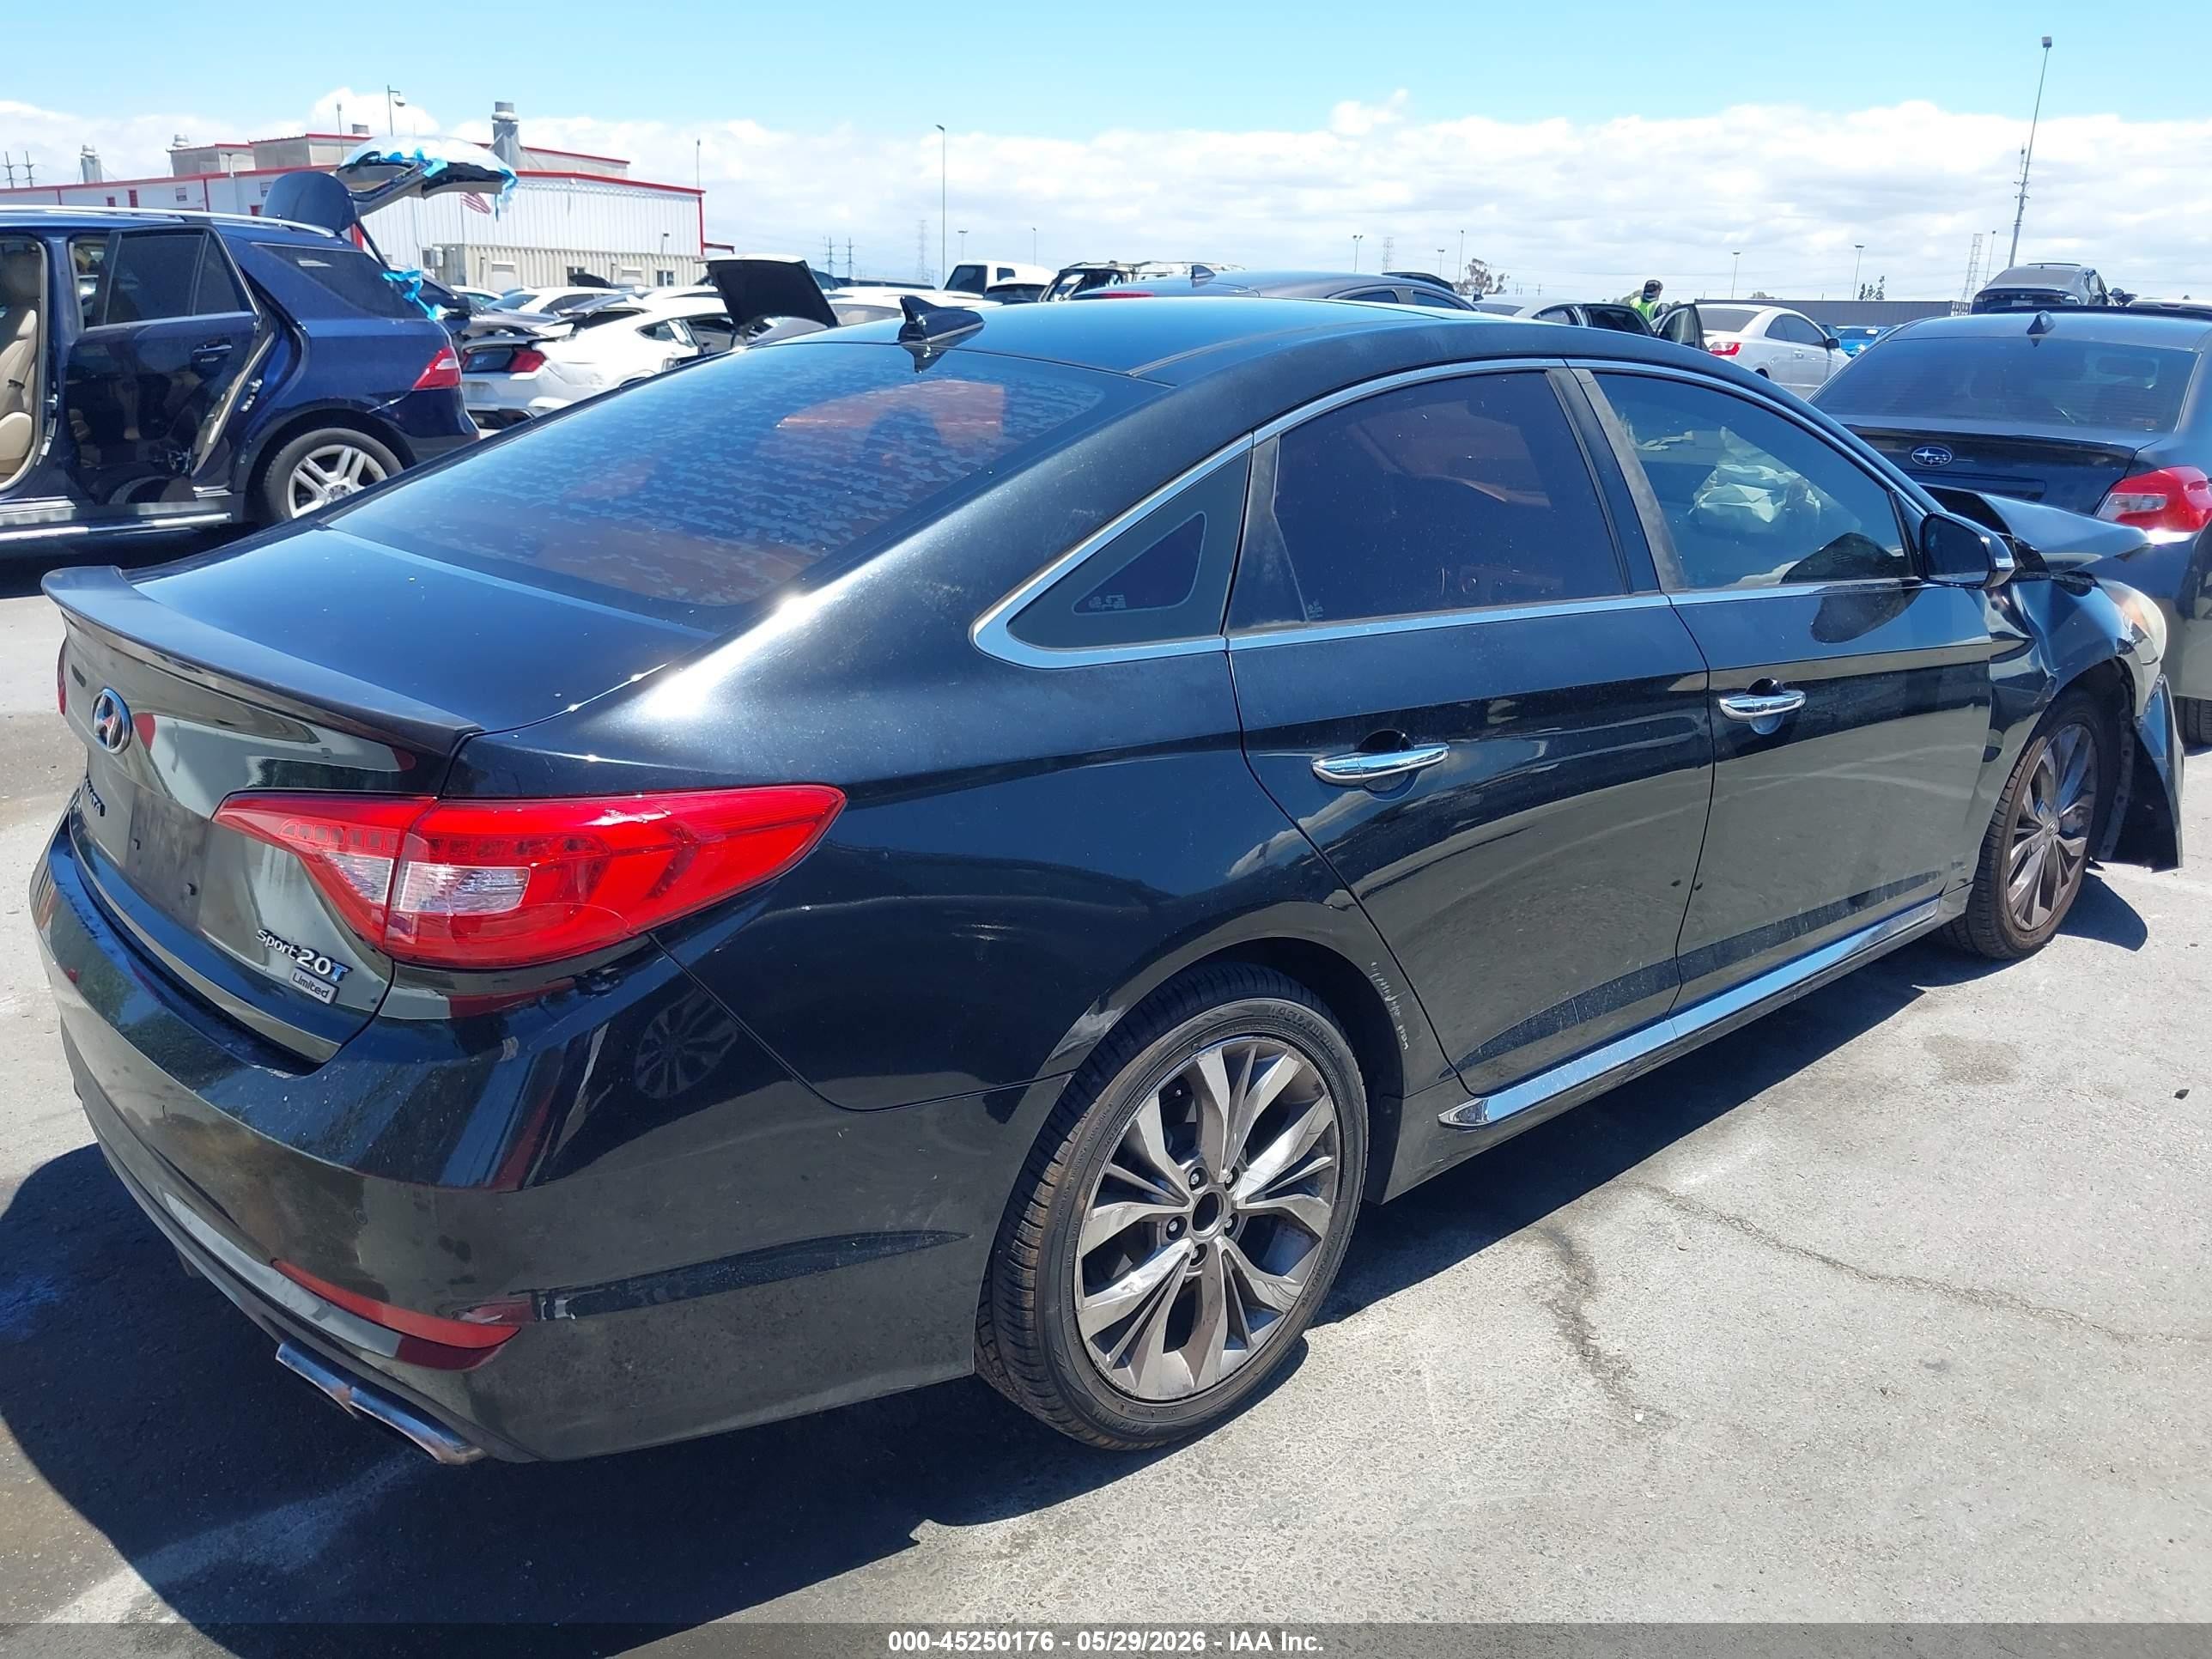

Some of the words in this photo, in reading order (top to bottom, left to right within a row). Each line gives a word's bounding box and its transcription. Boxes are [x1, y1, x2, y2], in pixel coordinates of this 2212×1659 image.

[255, 928, 297, 960] Sport
[296, 948, 349, 982] 2.0T
[292, 972, 330, 999] Limited
